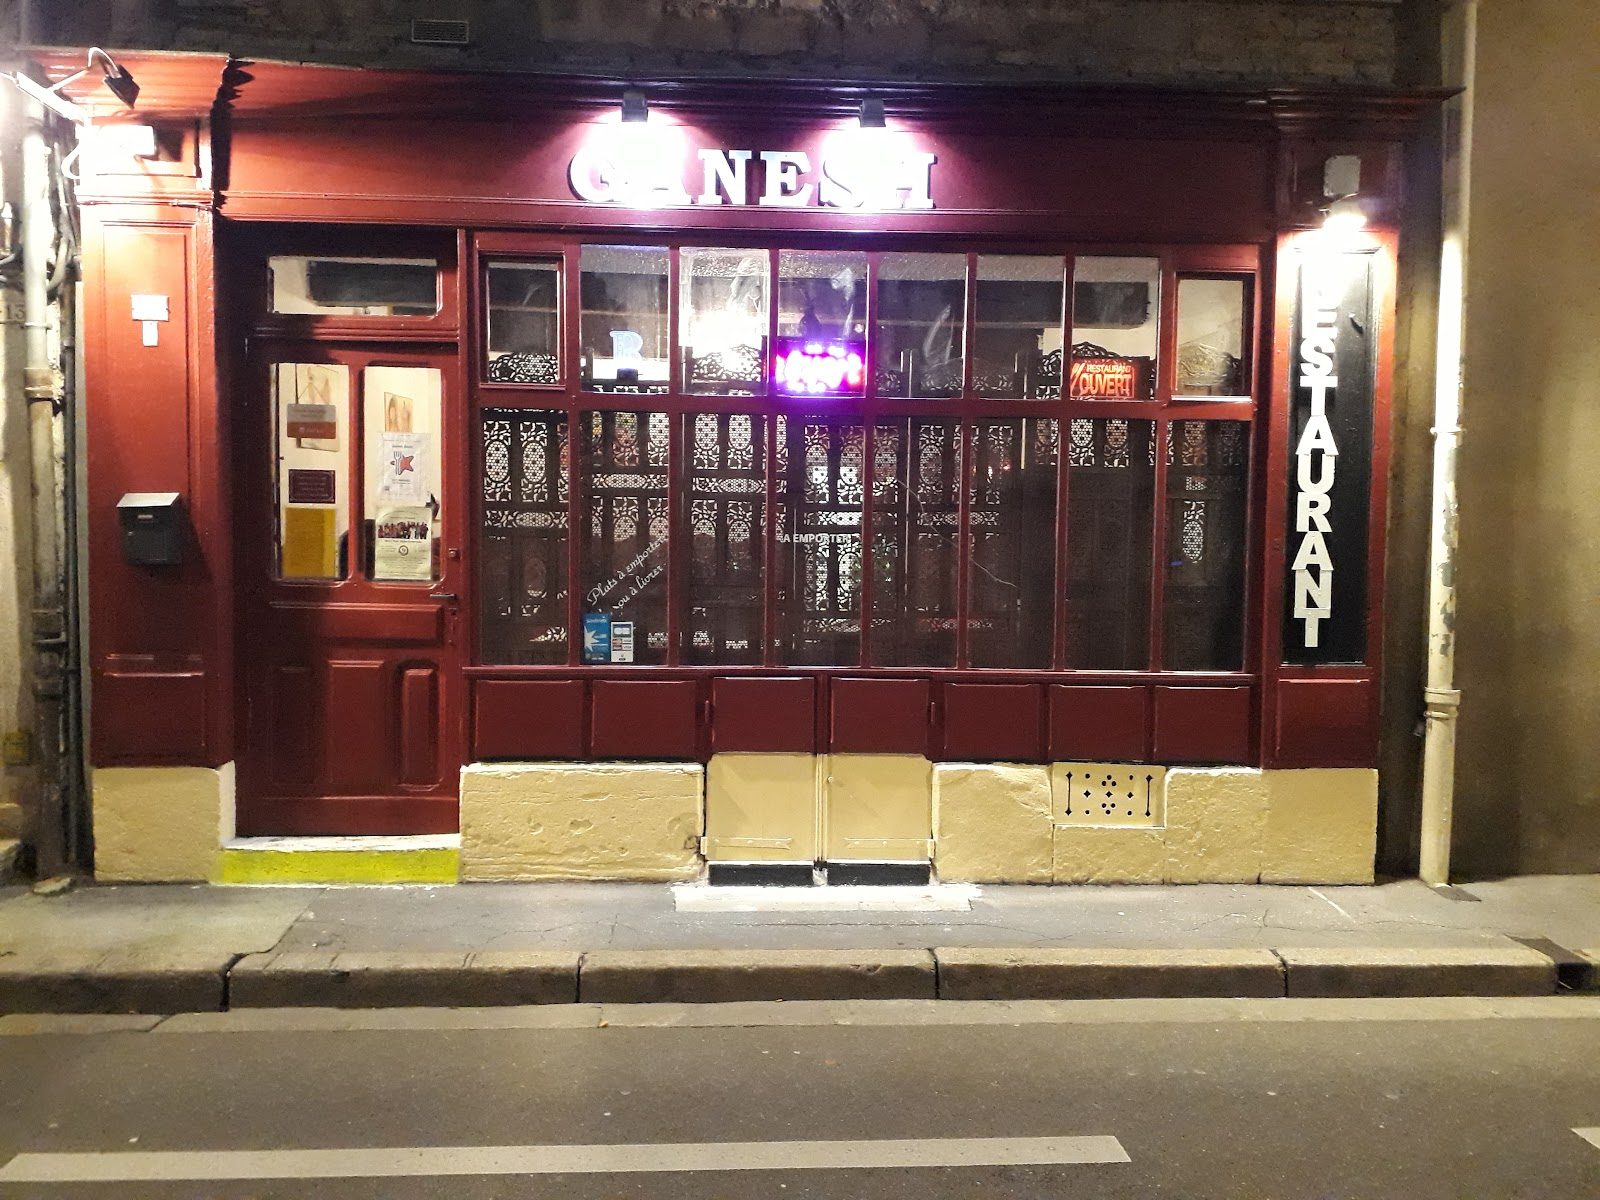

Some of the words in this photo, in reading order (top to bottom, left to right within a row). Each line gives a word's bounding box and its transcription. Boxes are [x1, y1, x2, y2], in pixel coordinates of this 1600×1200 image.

[1080, 372, 1133, 397] OUVERT
[1291, 264, 1340, 647] ESTAURANT
[793, 533, 851, 543] EMPORTER
[586, 582, 618, 606] Plats
[617, 595, 631, 608] ou
[635, 565, 665, 590] livrer
